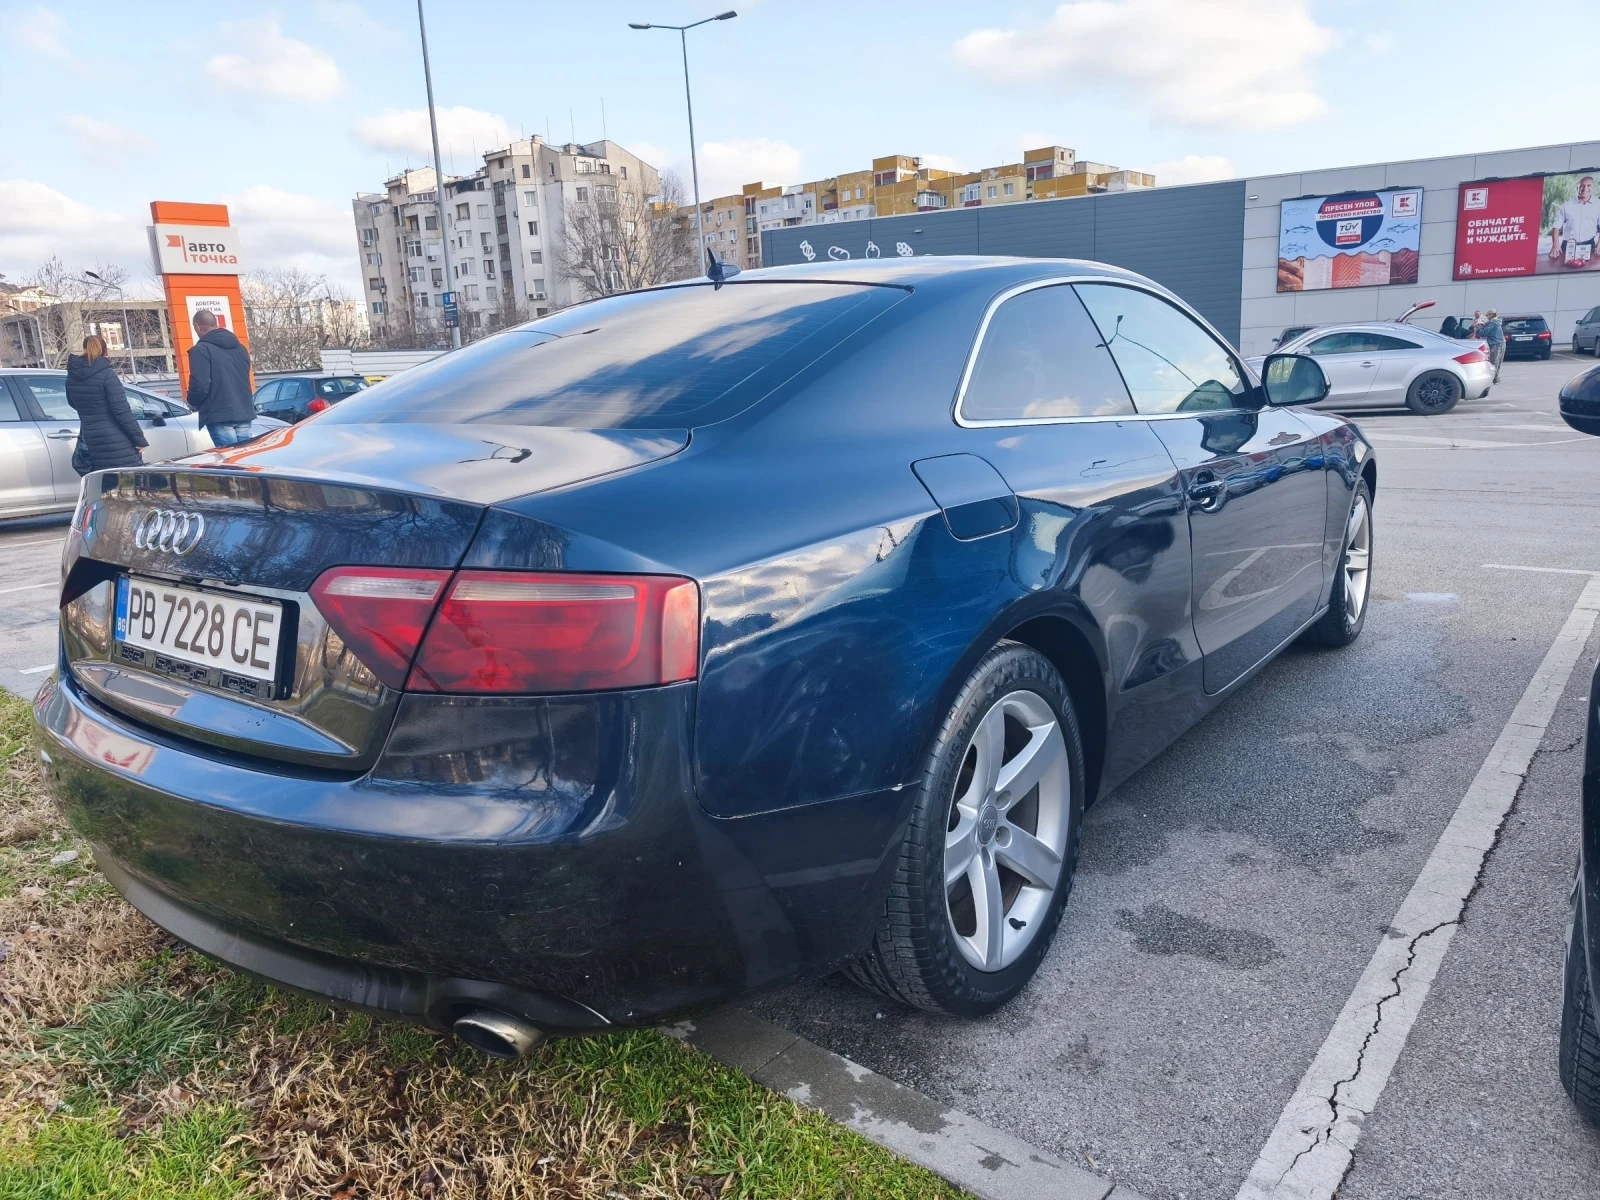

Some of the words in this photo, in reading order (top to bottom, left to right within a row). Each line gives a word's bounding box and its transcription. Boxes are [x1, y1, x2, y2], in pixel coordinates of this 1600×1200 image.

[1325, 203, 1353, 212] ПРЕСЕН
[1468, 217, 1508, 227] ОБИЧАТ
[1510, 216, 1525, 224] МЕ
[1476, 225, 1522, 235] НАШИТЕ,
[1475, 233, 1529, 243] ЧУЖДИТЕ.
[188, 242, 226, 253] авто
[190, 254, 238, 264] точка
[117, 616, 126, 632] BG
[128, 587, 156, 640] PB
[160, 593, 225, 657] 7228
[231, 608, 274, 670] CE
